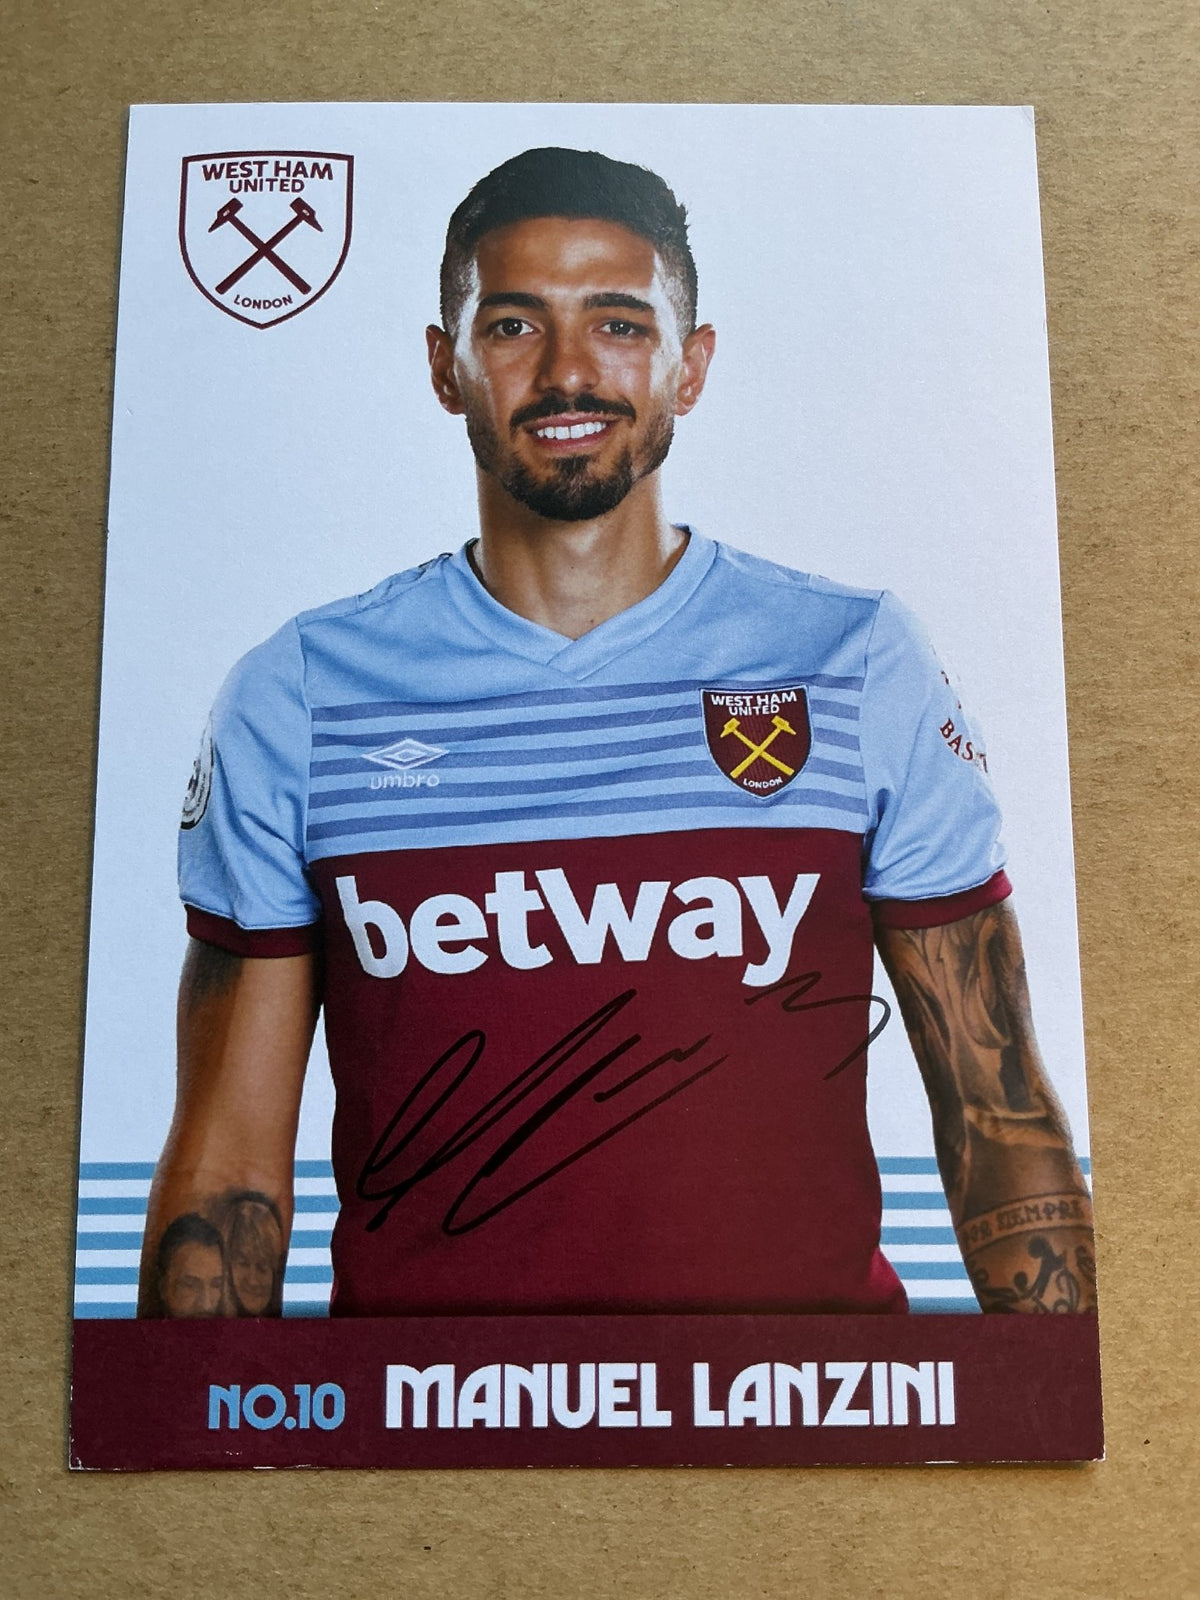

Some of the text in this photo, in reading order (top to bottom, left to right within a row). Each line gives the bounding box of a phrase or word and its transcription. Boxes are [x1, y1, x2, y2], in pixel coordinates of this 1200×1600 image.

[202, 160, 334, 182] WEST HAM
[229, 178, 305, 194] UNITED
[233, 294, 293, 310] LONDON
[710, 690, 798, 707] WEST HAM
[728, 704, 780, 716] UNITED
[370, 772, 440, 790] umbro
[743, 776, 783, 789] LONDON
[335, 867, 821, 987] betway
[385, 1361, 956, 1429] MANUEL LANZINI
[208, 1382, 346, 1430] NO.10
